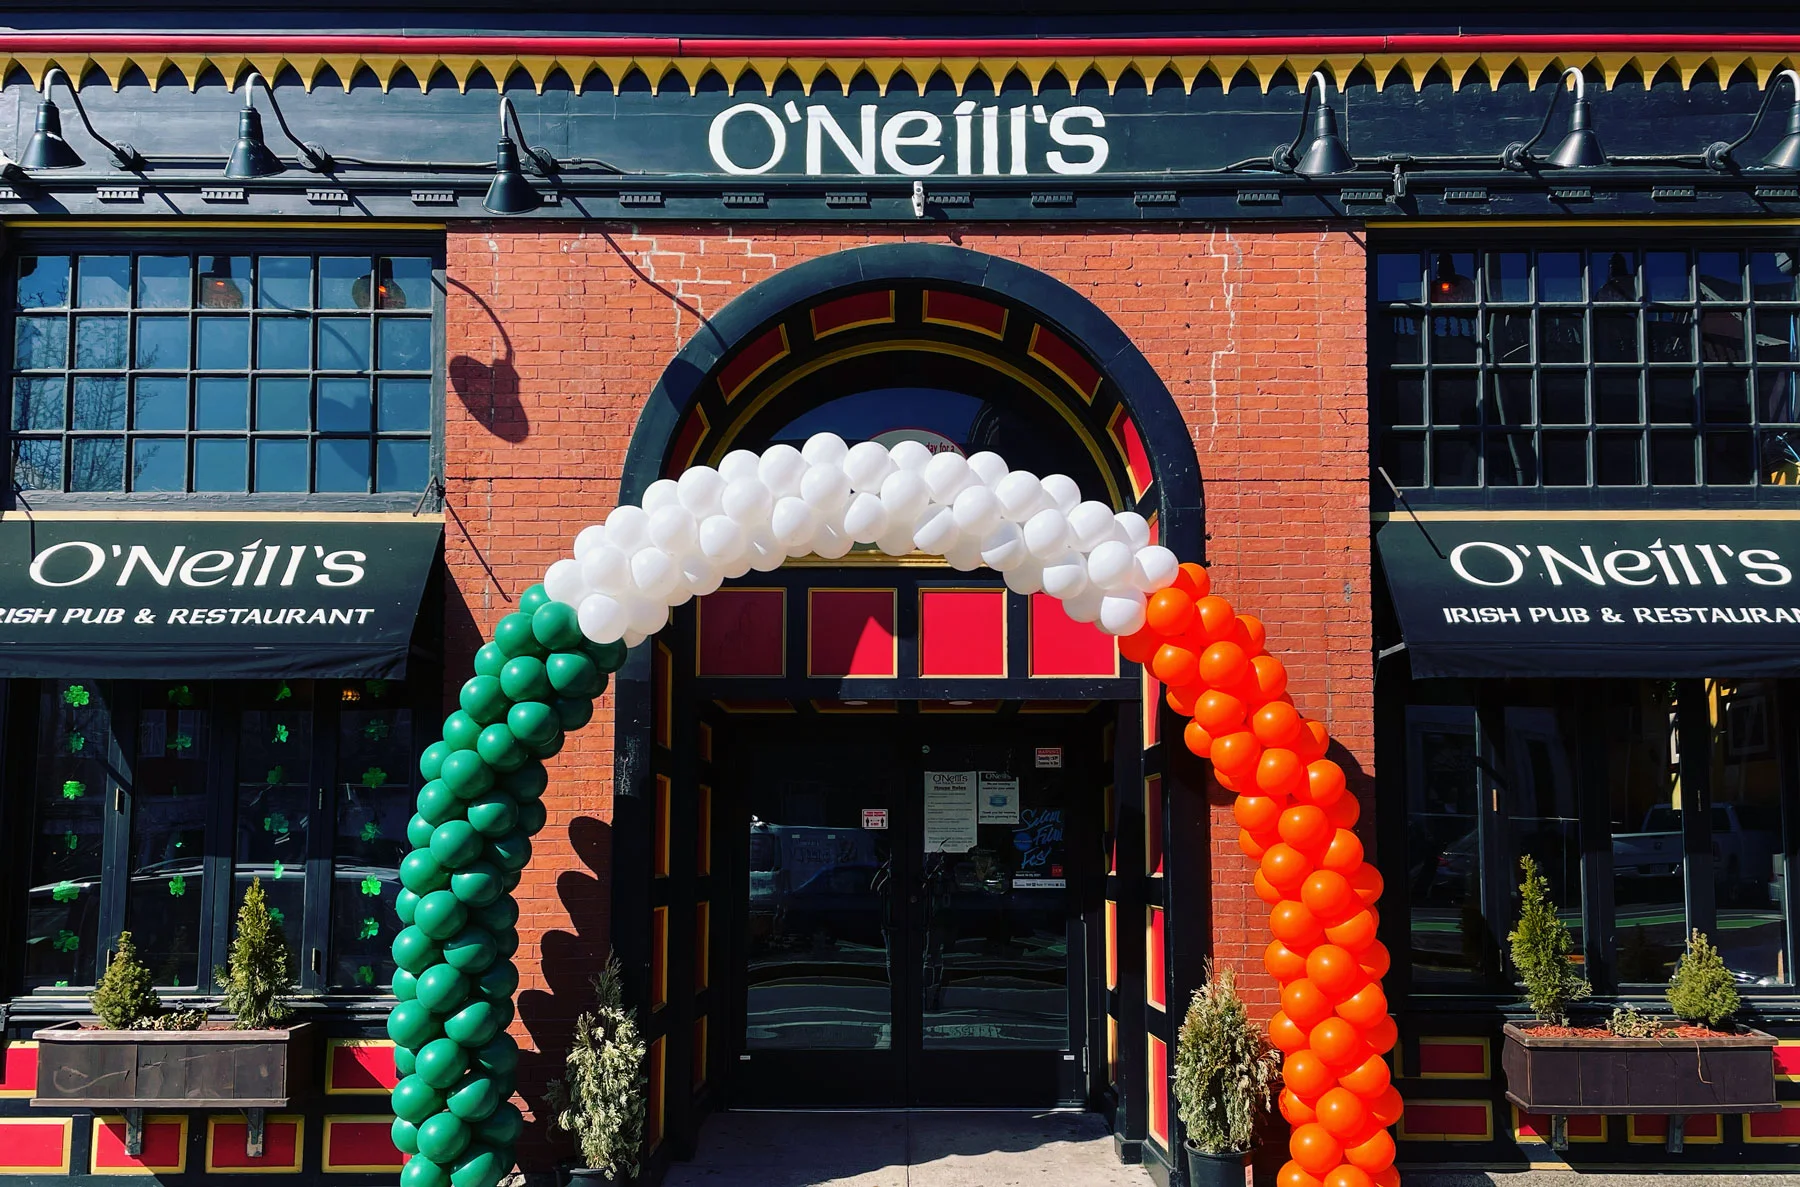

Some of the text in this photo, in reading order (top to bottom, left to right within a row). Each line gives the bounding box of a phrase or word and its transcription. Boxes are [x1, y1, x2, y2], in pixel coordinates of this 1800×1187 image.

[62, 607, 126, 624] PUB
[133, 608, 157, 624] &
[166, 608, 375, 625] RESTAURANT
[1442, 607, 1522, 624] IRISH
[1528, 607, 1591, 623] PUB
[1600, 607, 1626, 623] &
[1033, 824, 1064, 846] Film
